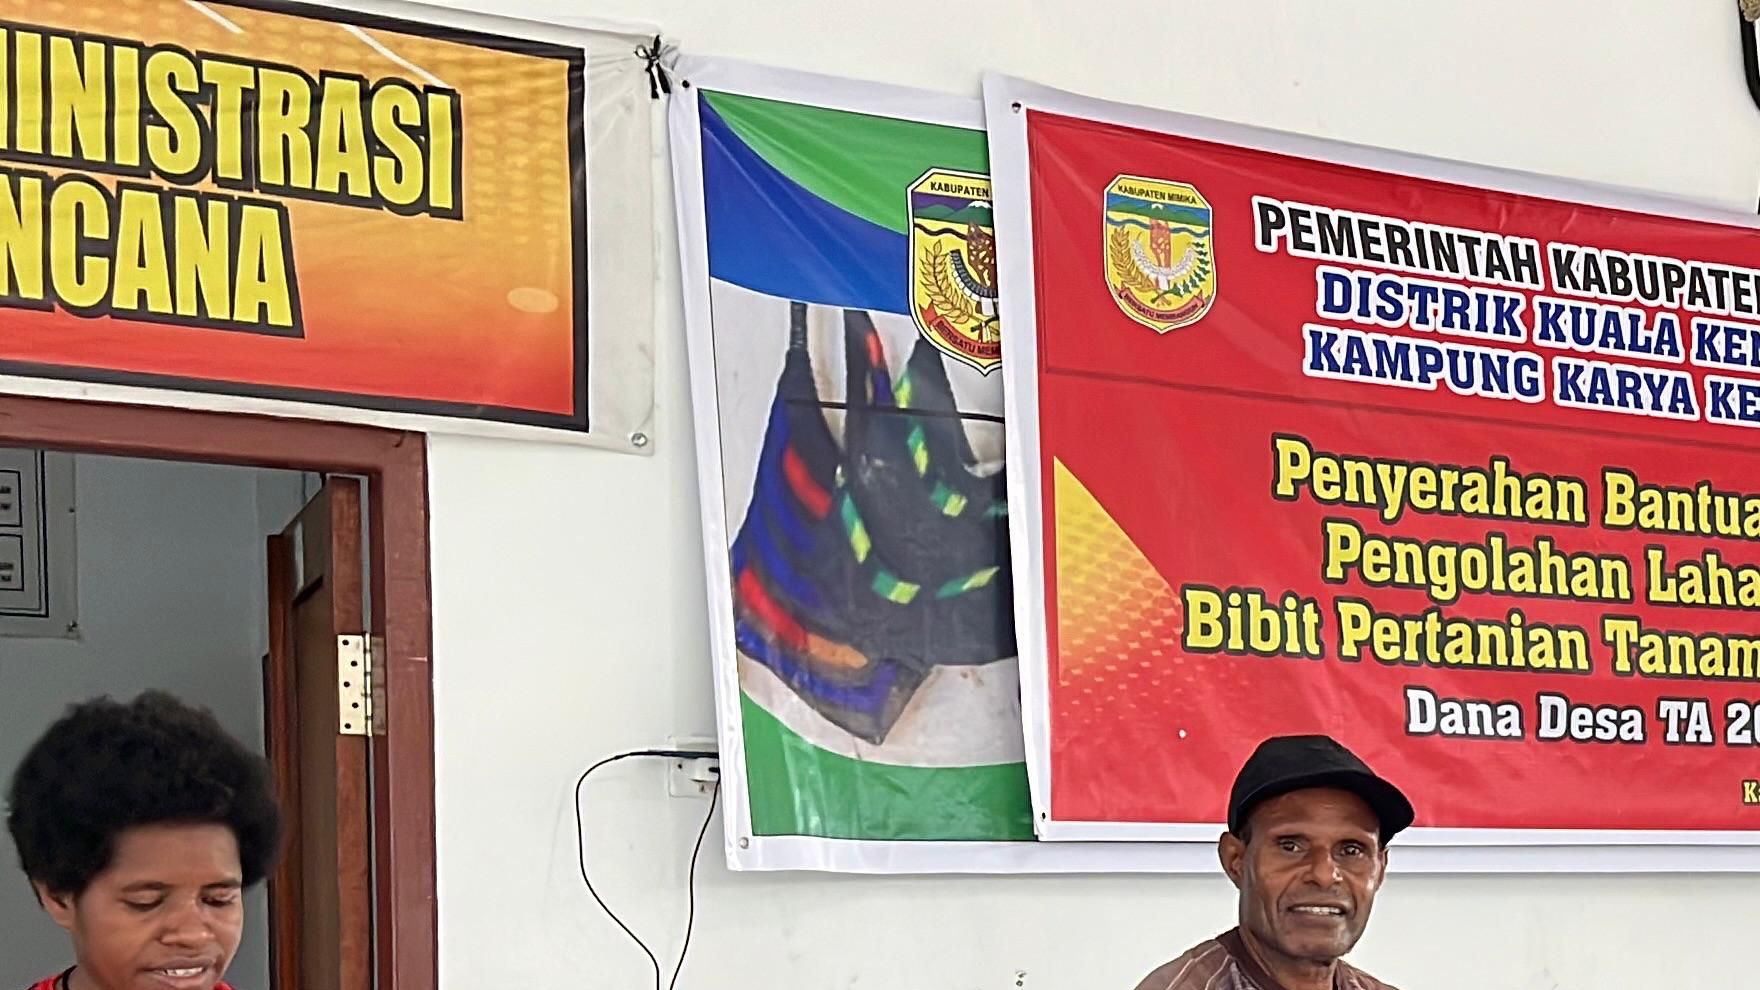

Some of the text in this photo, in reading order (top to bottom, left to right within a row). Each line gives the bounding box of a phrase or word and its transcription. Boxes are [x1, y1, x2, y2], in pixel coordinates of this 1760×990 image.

[0, 27, 455, 210] INISTRASI
[930, 181, 990, 198] KABUPATEN
[1118, 184, 1197, 204] KABUPATEN MIMIKA
[0, 173, 294, 328] NCANA
[1257, 201, 1540, 286] PEMERINTAH
[1322, 272, 1521, 338] DISTRIK
[1537, 301, 1681, 358] KUALA
[1309, 329, 1540, 397] KAMPUNG
[1557, 361, 1696, 416] KARYA
[1274, 437, 1587, 523] Penyerahan
[1326, 521, 1631, 601] Pengolahan
[1184, 588, 1321, 656] Bibit
[1337, 600, 1590, 671] Pertanian
[1406, 688, 1522, 738] Dana
[1538, 694, 1644, 742] Desa
[1658, 700, 1713, 744] TA
